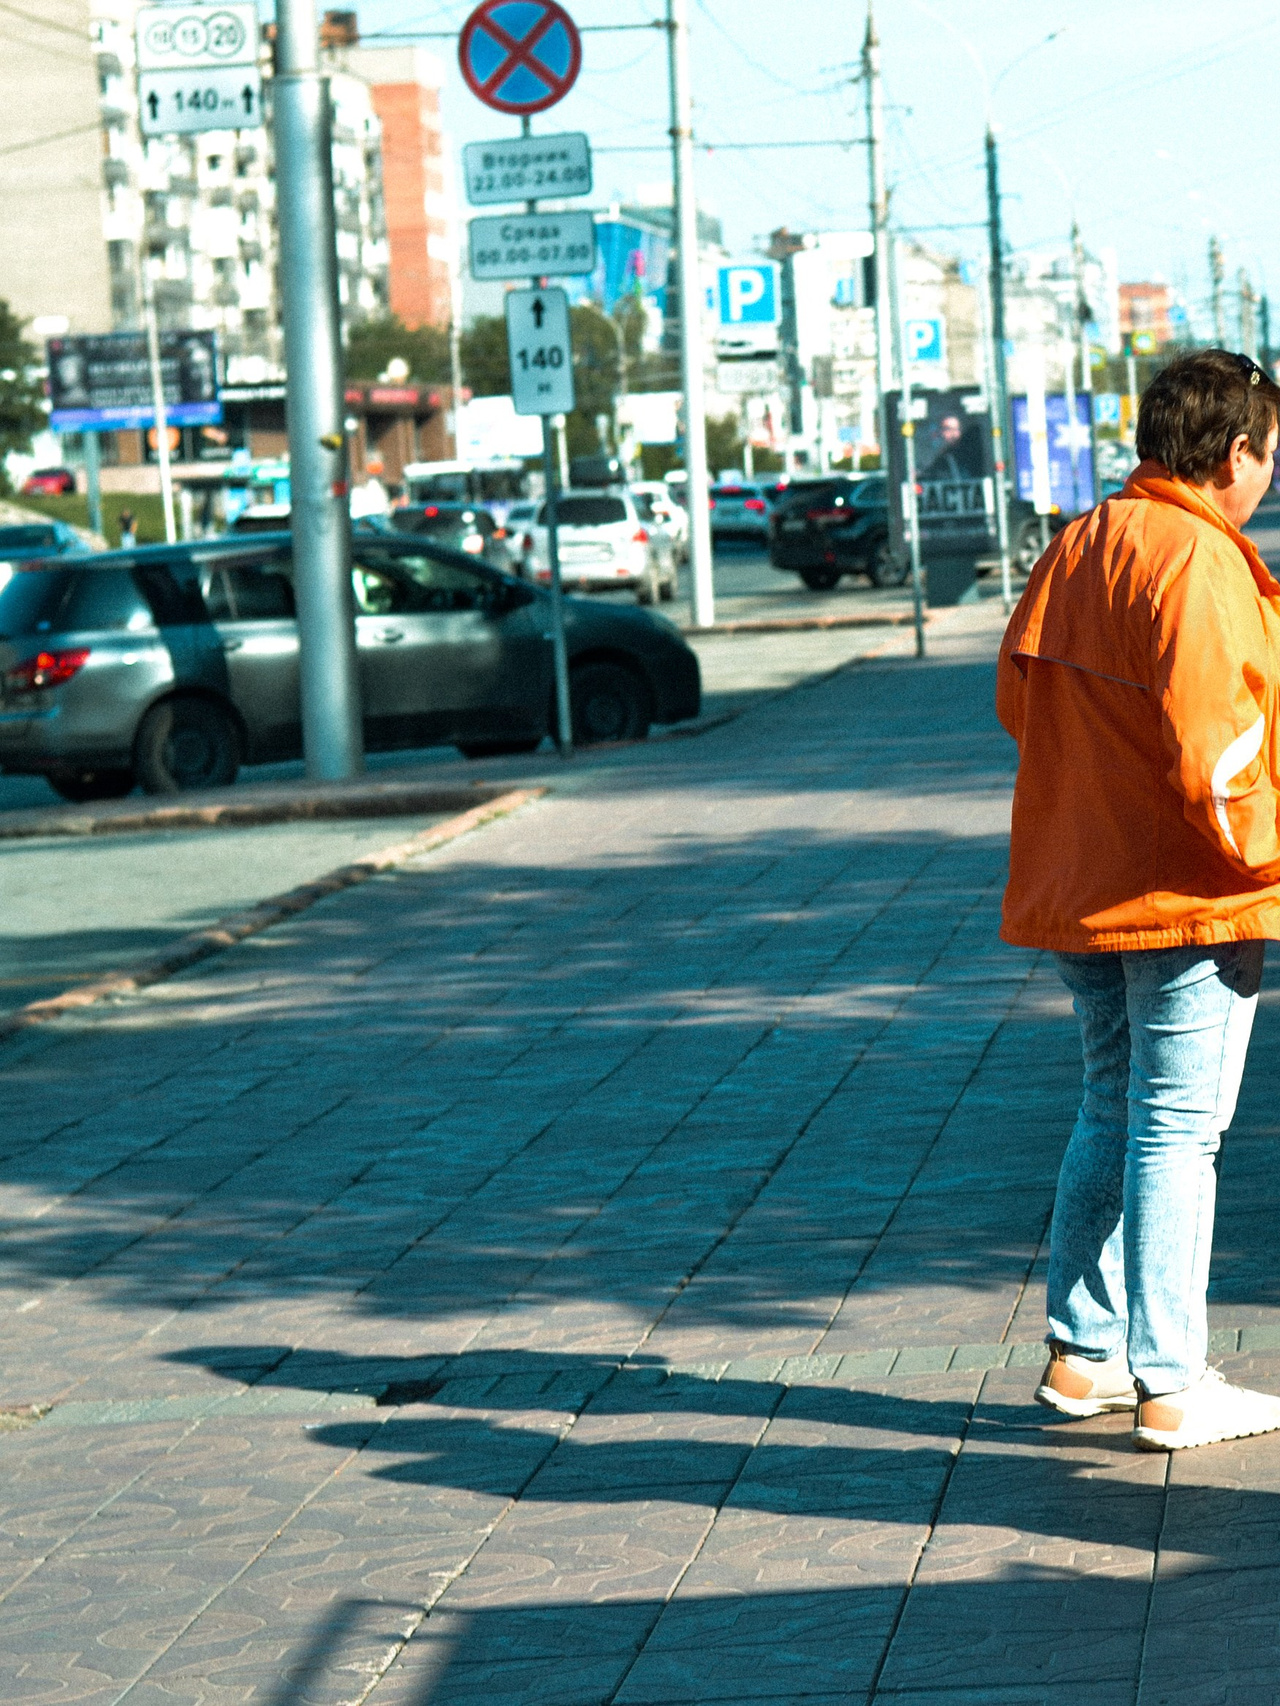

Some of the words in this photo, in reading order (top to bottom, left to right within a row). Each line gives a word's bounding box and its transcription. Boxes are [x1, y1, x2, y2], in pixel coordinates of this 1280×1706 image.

[214, 23, 239, 46] 20
[174, 88, 219, 113] 140
[482, 150, 568, 170] Вторник
[501, 224, 560, 242] Среда
[728, 269, 765, 321] P
[908, 322, 934, 359] P
[517, 345, 564, 371] 140
